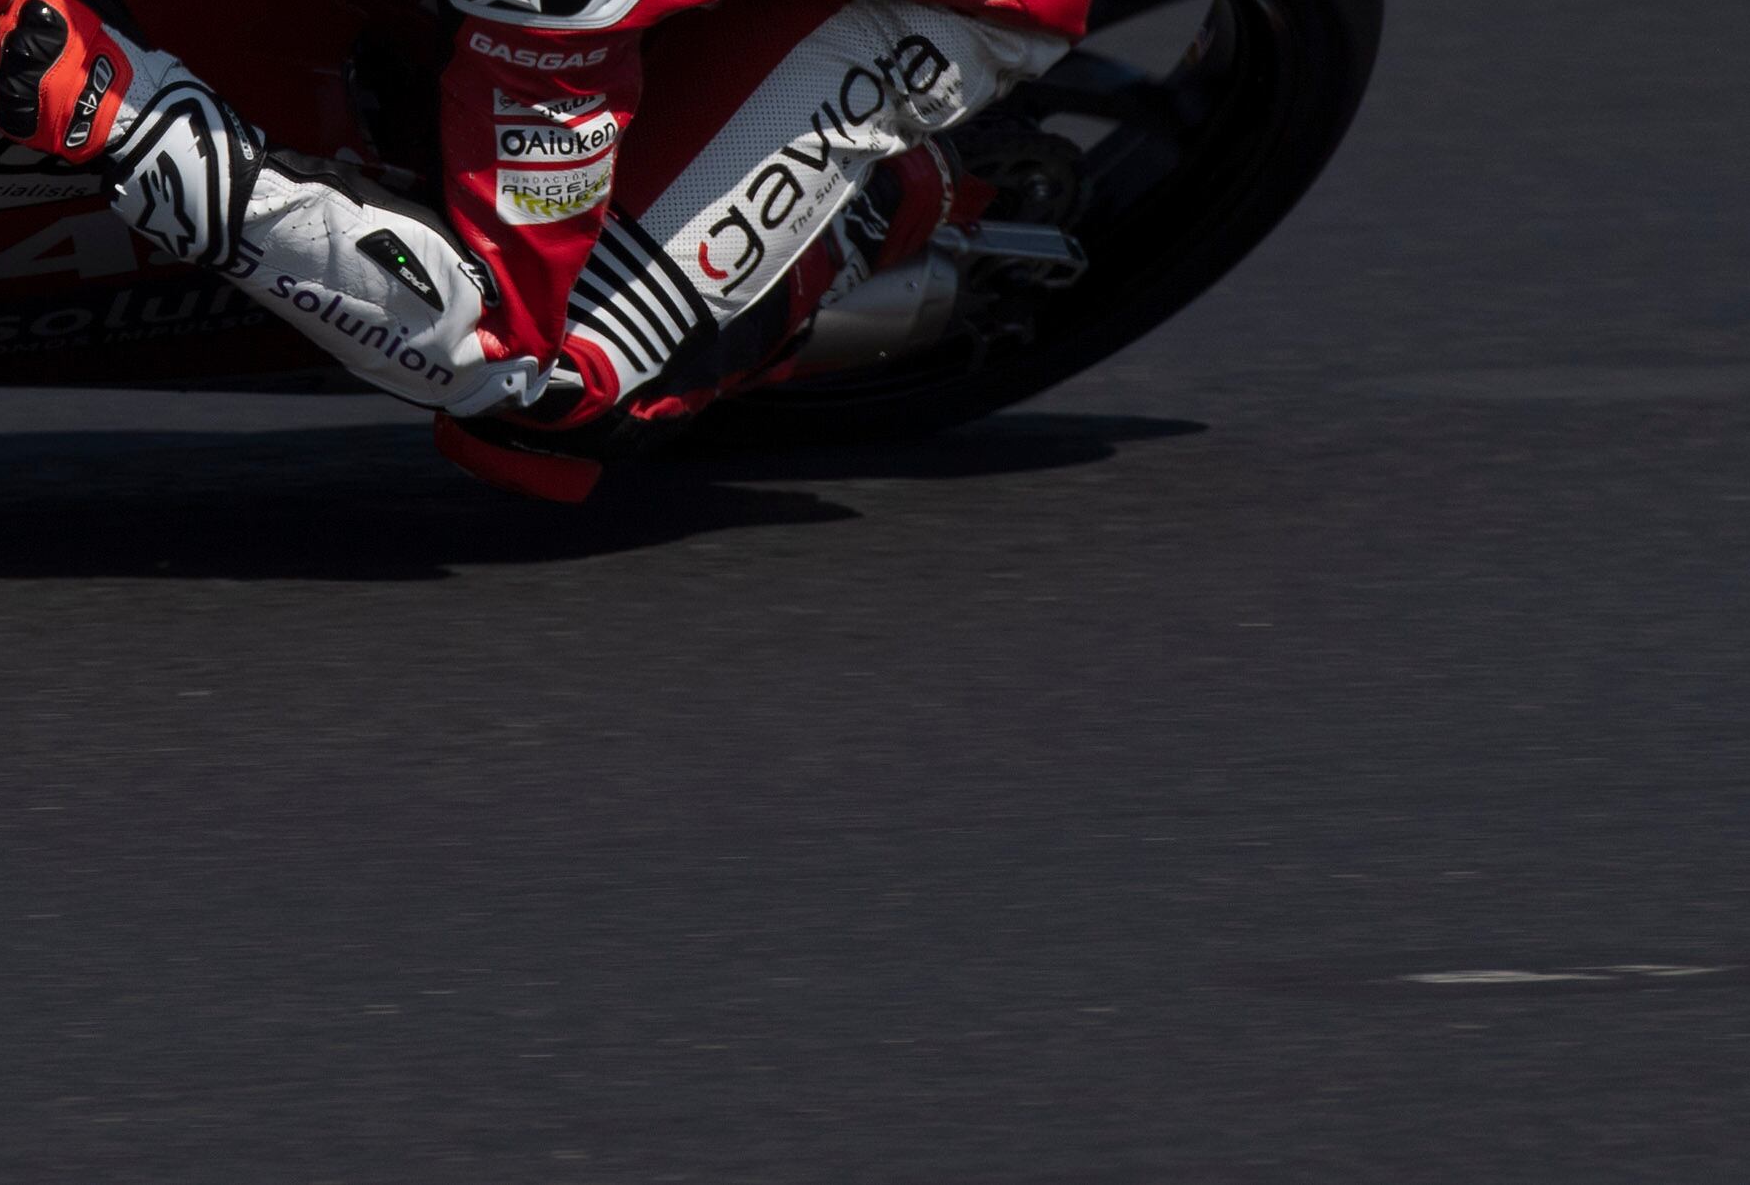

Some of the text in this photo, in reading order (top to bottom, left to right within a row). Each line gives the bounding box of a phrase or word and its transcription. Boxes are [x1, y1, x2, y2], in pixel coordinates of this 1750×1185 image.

[469, 31, 609, 71] GASGAS
[525, 121, 617, 155] Aiuken
[789, 205, 814, 236] The
[815, 171, 841, 207] Sun
[268, 275, 454, 386] solunion
